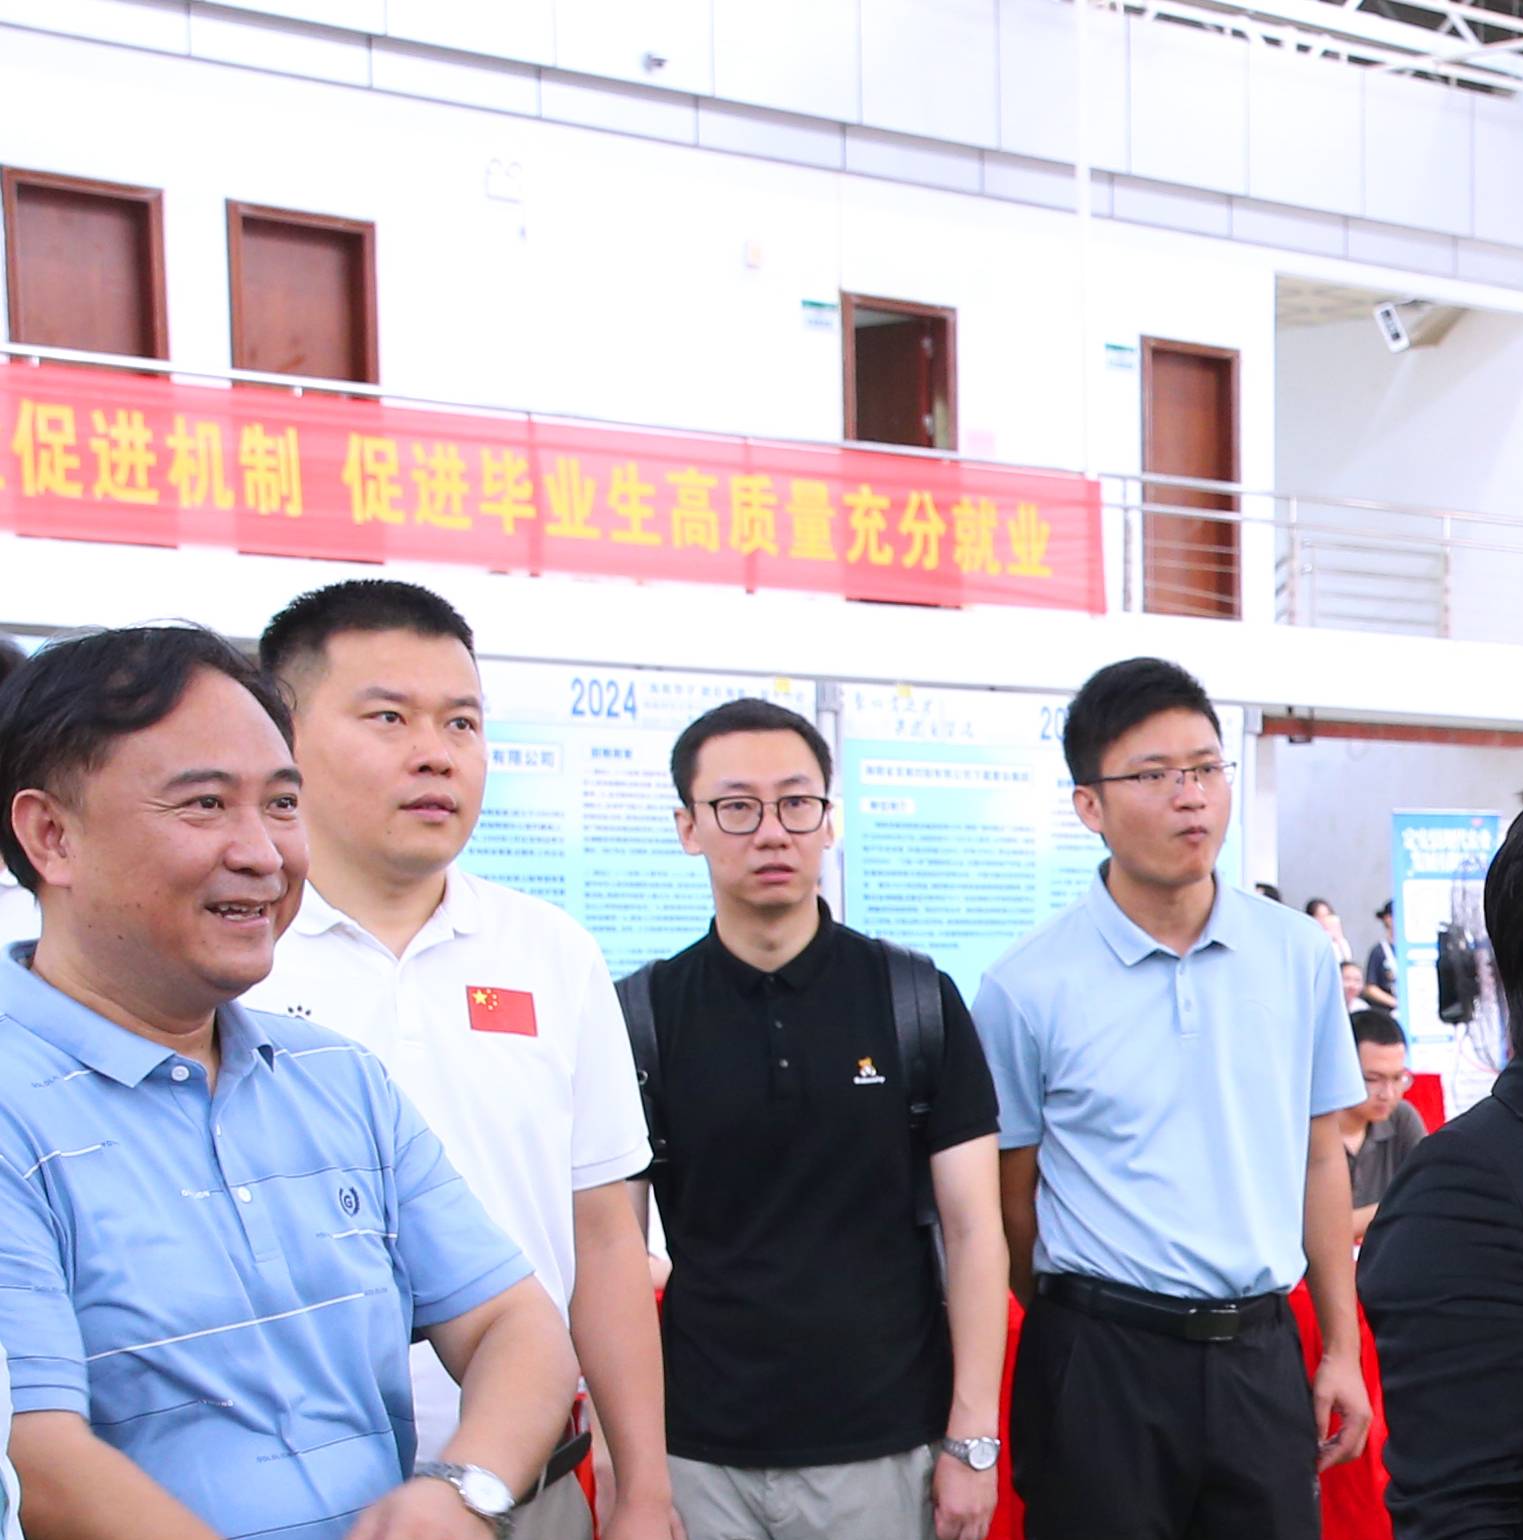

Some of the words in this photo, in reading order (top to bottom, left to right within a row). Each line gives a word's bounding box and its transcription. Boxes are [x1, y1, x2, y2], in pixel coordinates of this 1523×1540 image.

[0, 399, 302, 517] 促进机制
[342, 432, 1053, 577] 促进毕业生高质量充分就业
[570, 678, 638, 721] 2024
